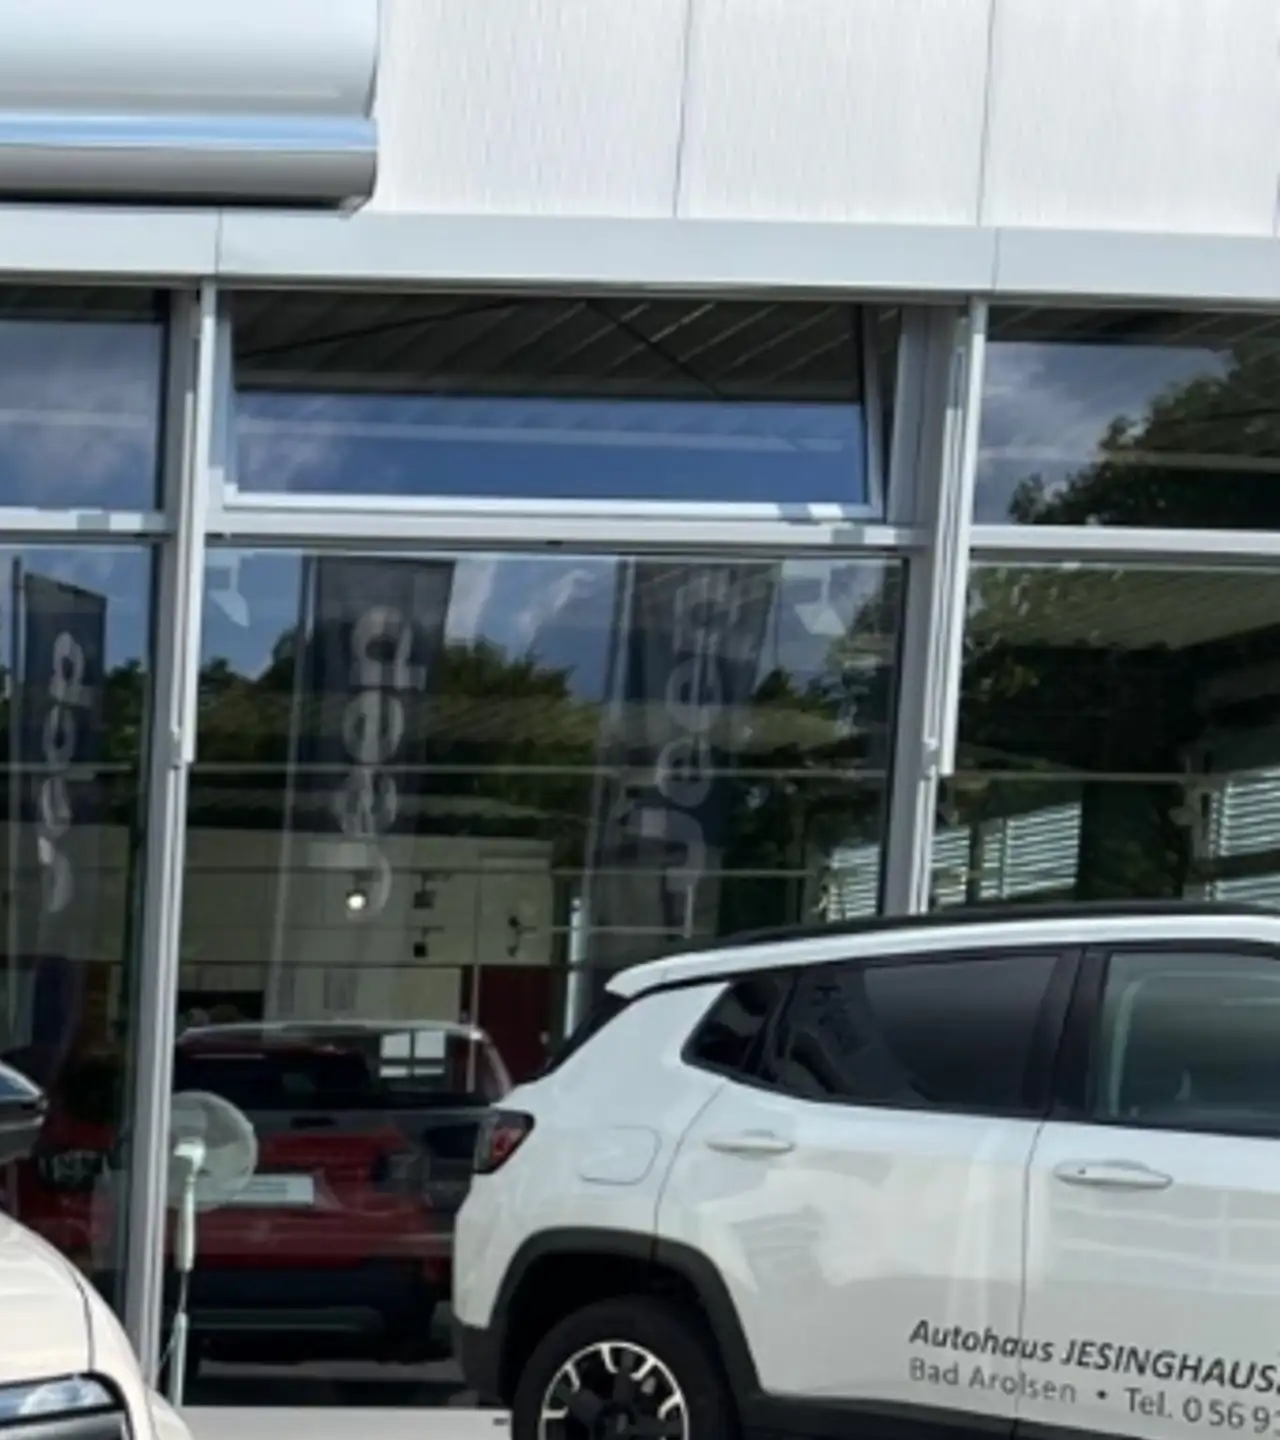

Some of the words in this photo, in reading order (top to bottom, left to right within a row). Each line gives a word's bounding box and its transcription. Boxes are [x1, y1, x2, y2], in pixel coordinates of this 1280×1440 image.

[909, 1319, 1055, 1363] Autohaus
[1060, 1338, 1280, 1394] JESINGHAUS
[909, 1356, 960, 1386] Bad
[968, 1365, 1077, 1404] Arolsen
[1124, 1387, 1173, 1419] Tel.
